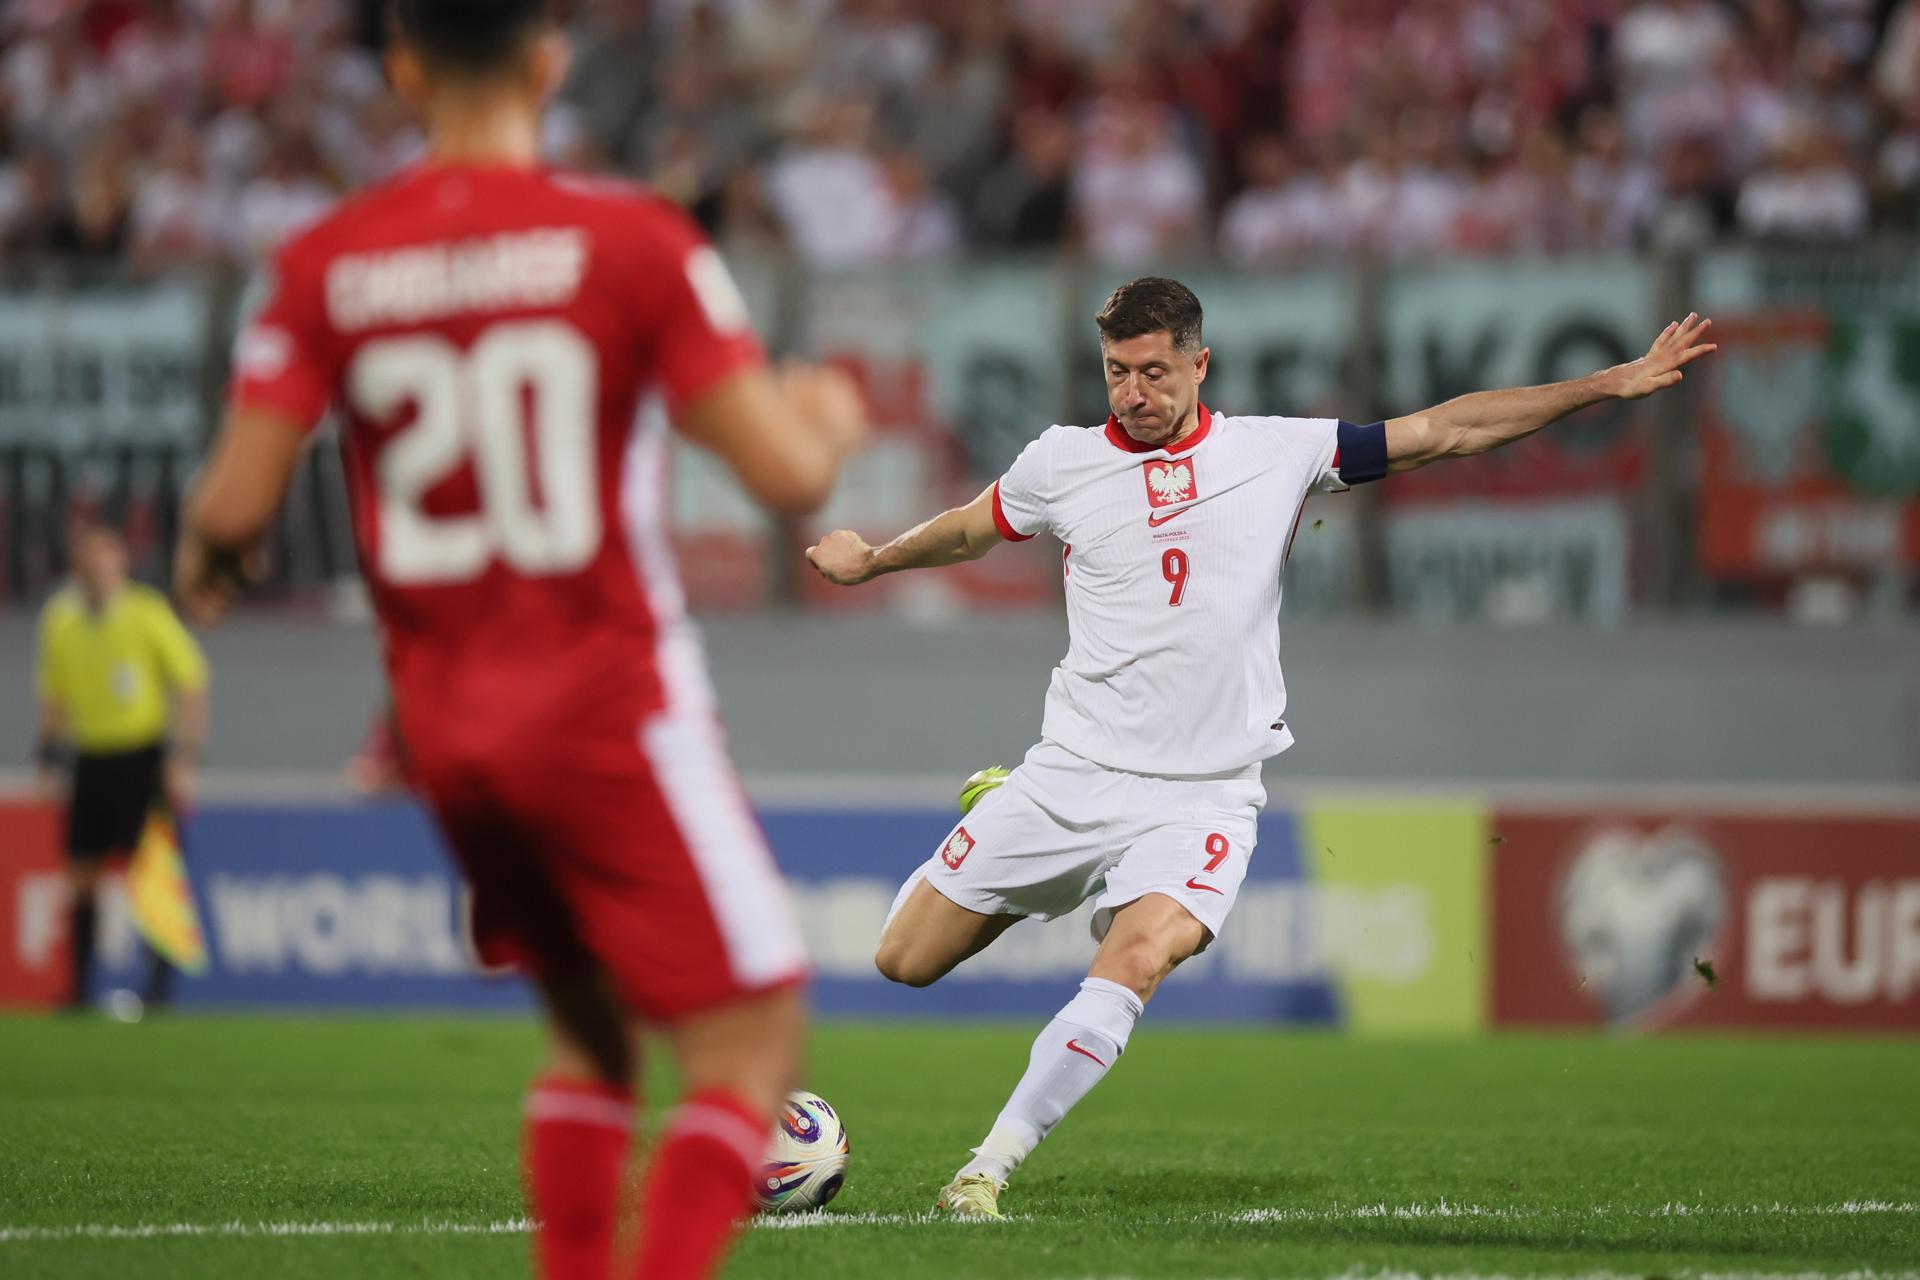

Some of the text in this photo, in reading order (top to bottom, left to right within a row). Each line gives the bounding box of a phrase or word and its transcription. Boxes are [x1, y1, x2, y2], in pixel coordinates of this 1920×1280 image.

[349, 319, 598, 582] 20
[1161, 547, 1190, 607] 9
[1203, 833, 1230, 874] 9
[208, 873, 465, 975] WORL
